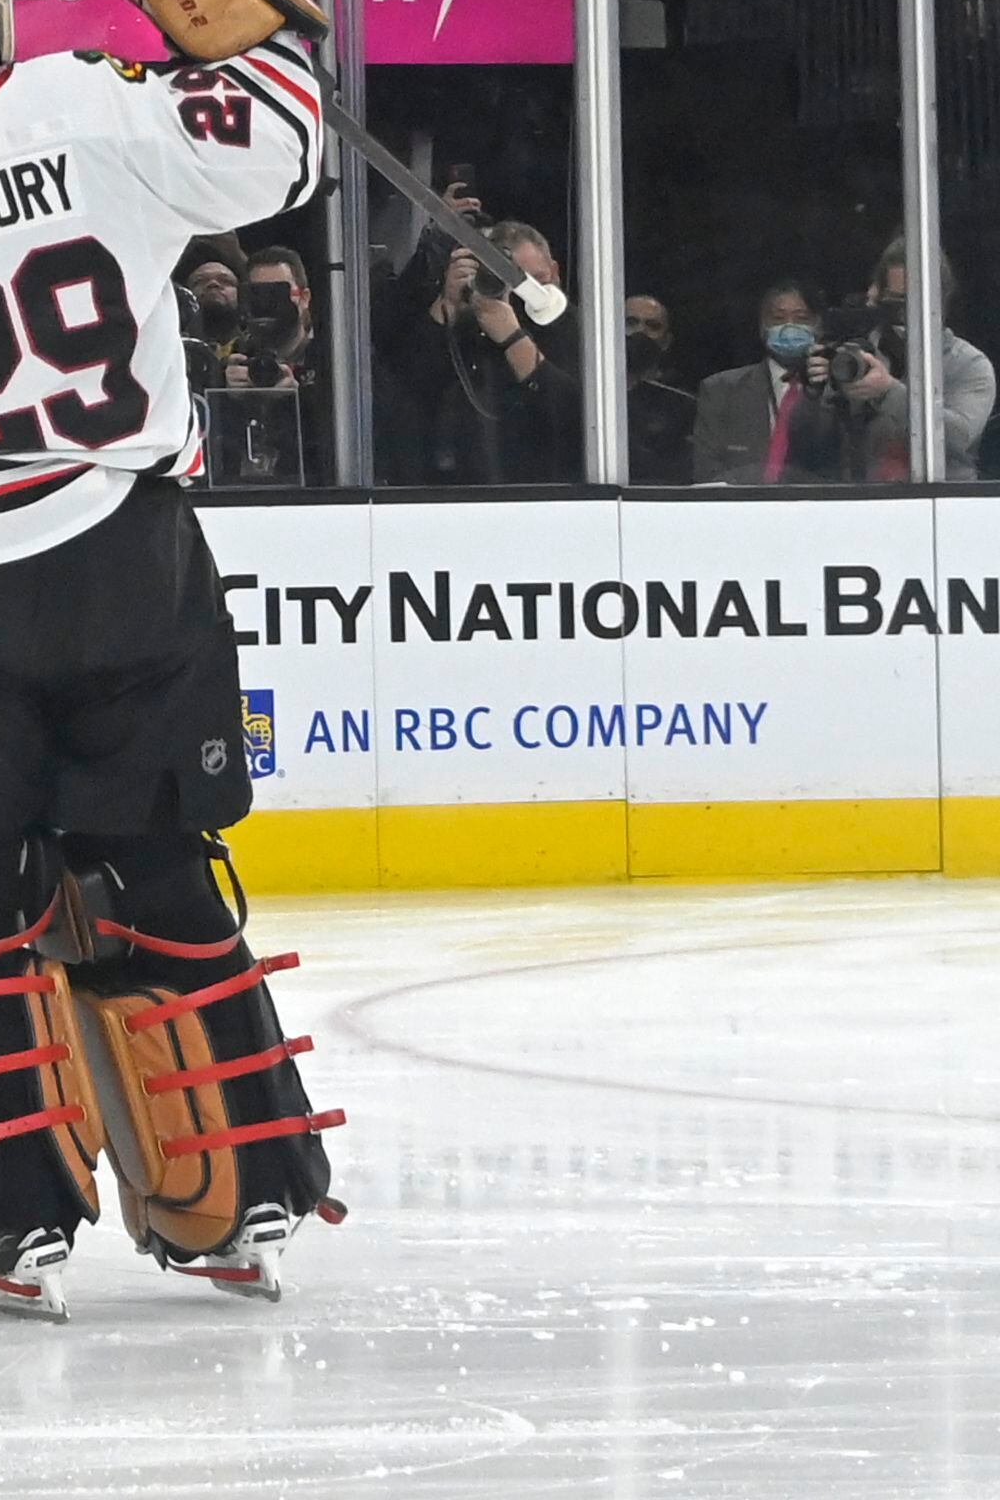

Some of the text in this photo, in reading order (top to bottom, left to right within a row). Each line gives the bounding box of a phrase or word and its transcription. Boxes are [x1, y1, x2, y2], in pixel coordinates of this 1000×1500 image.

[388, 570, 808, 642] NATIONAL
[303, 701, 768, 754] AN RBC COMPANY
